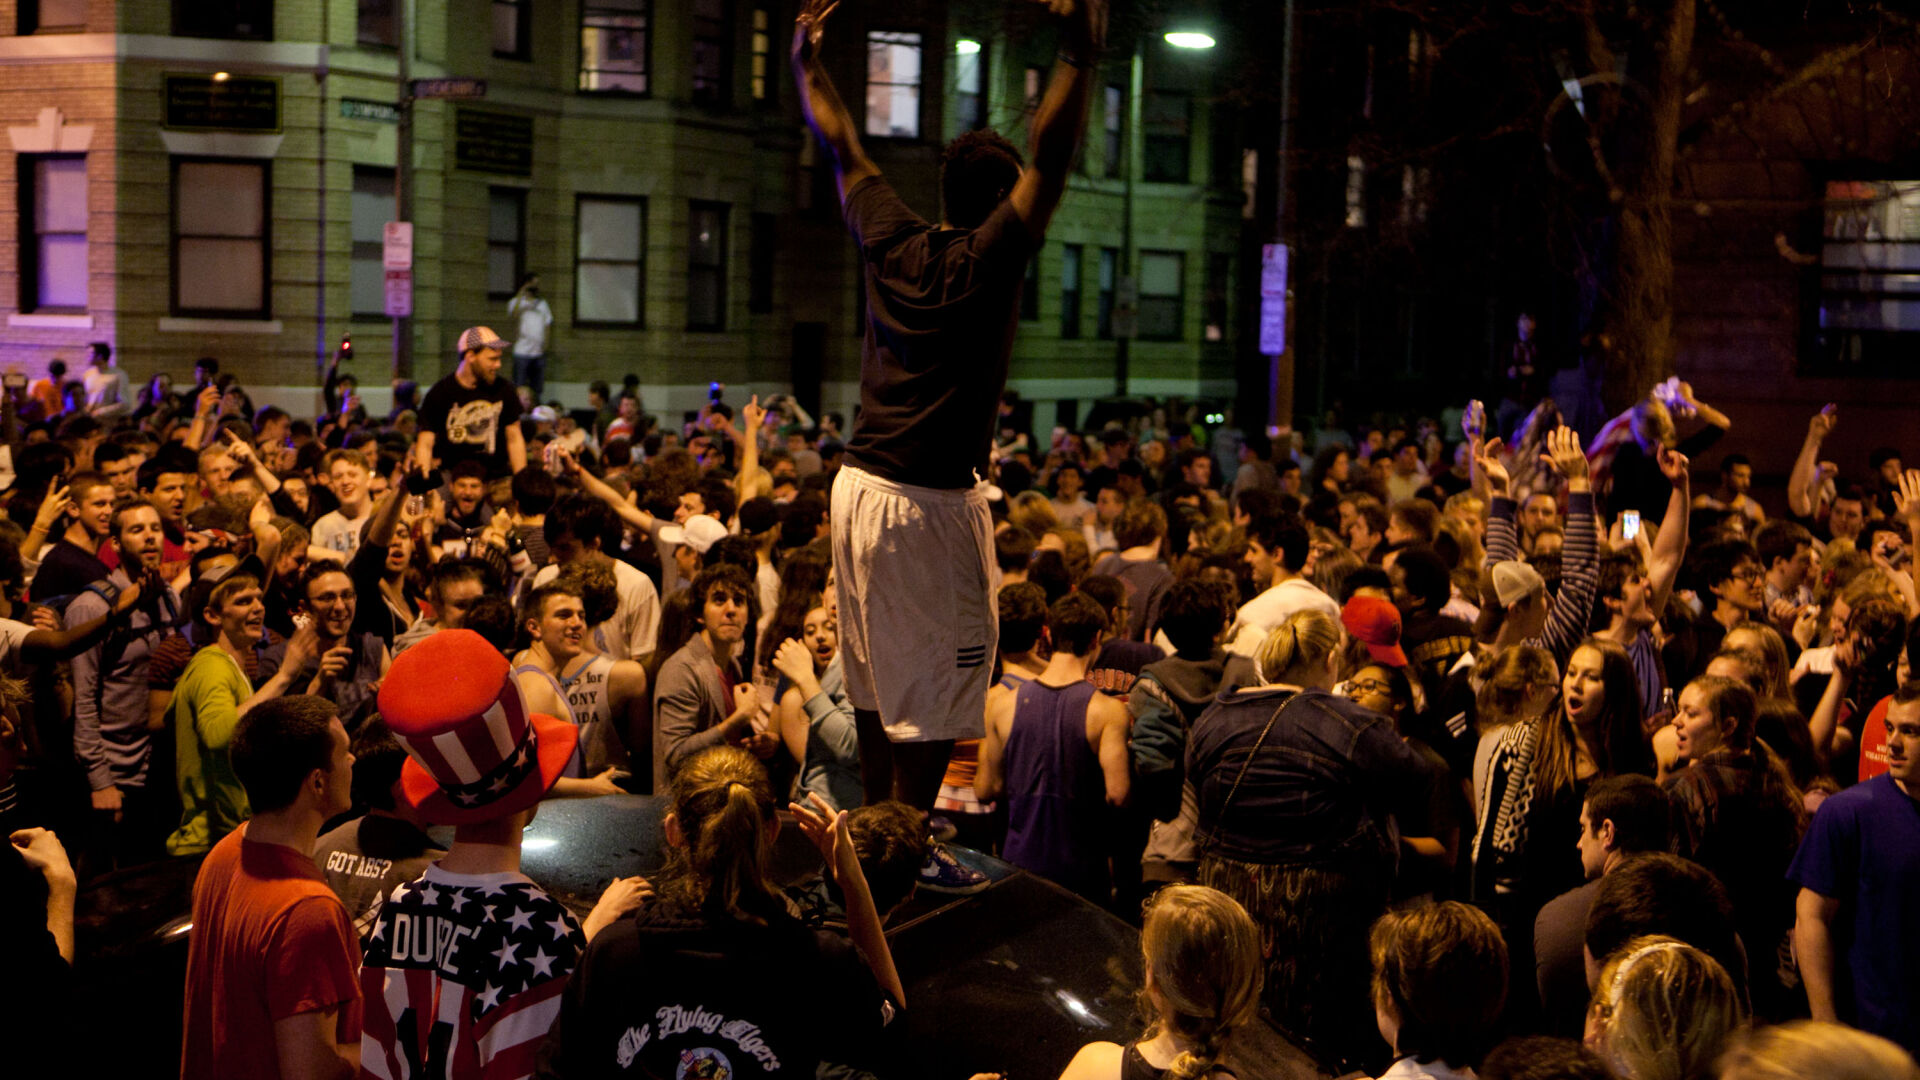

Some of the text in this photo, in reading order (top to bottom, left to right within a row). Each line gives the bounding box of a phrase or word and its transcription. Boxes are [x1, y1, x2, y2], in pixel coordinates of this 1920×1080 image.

[587, 672, 603, 683] for
[327, 851, 392, 880] GOT ABS?
[617, 1003, 782, 1072] The Flying Tigers
